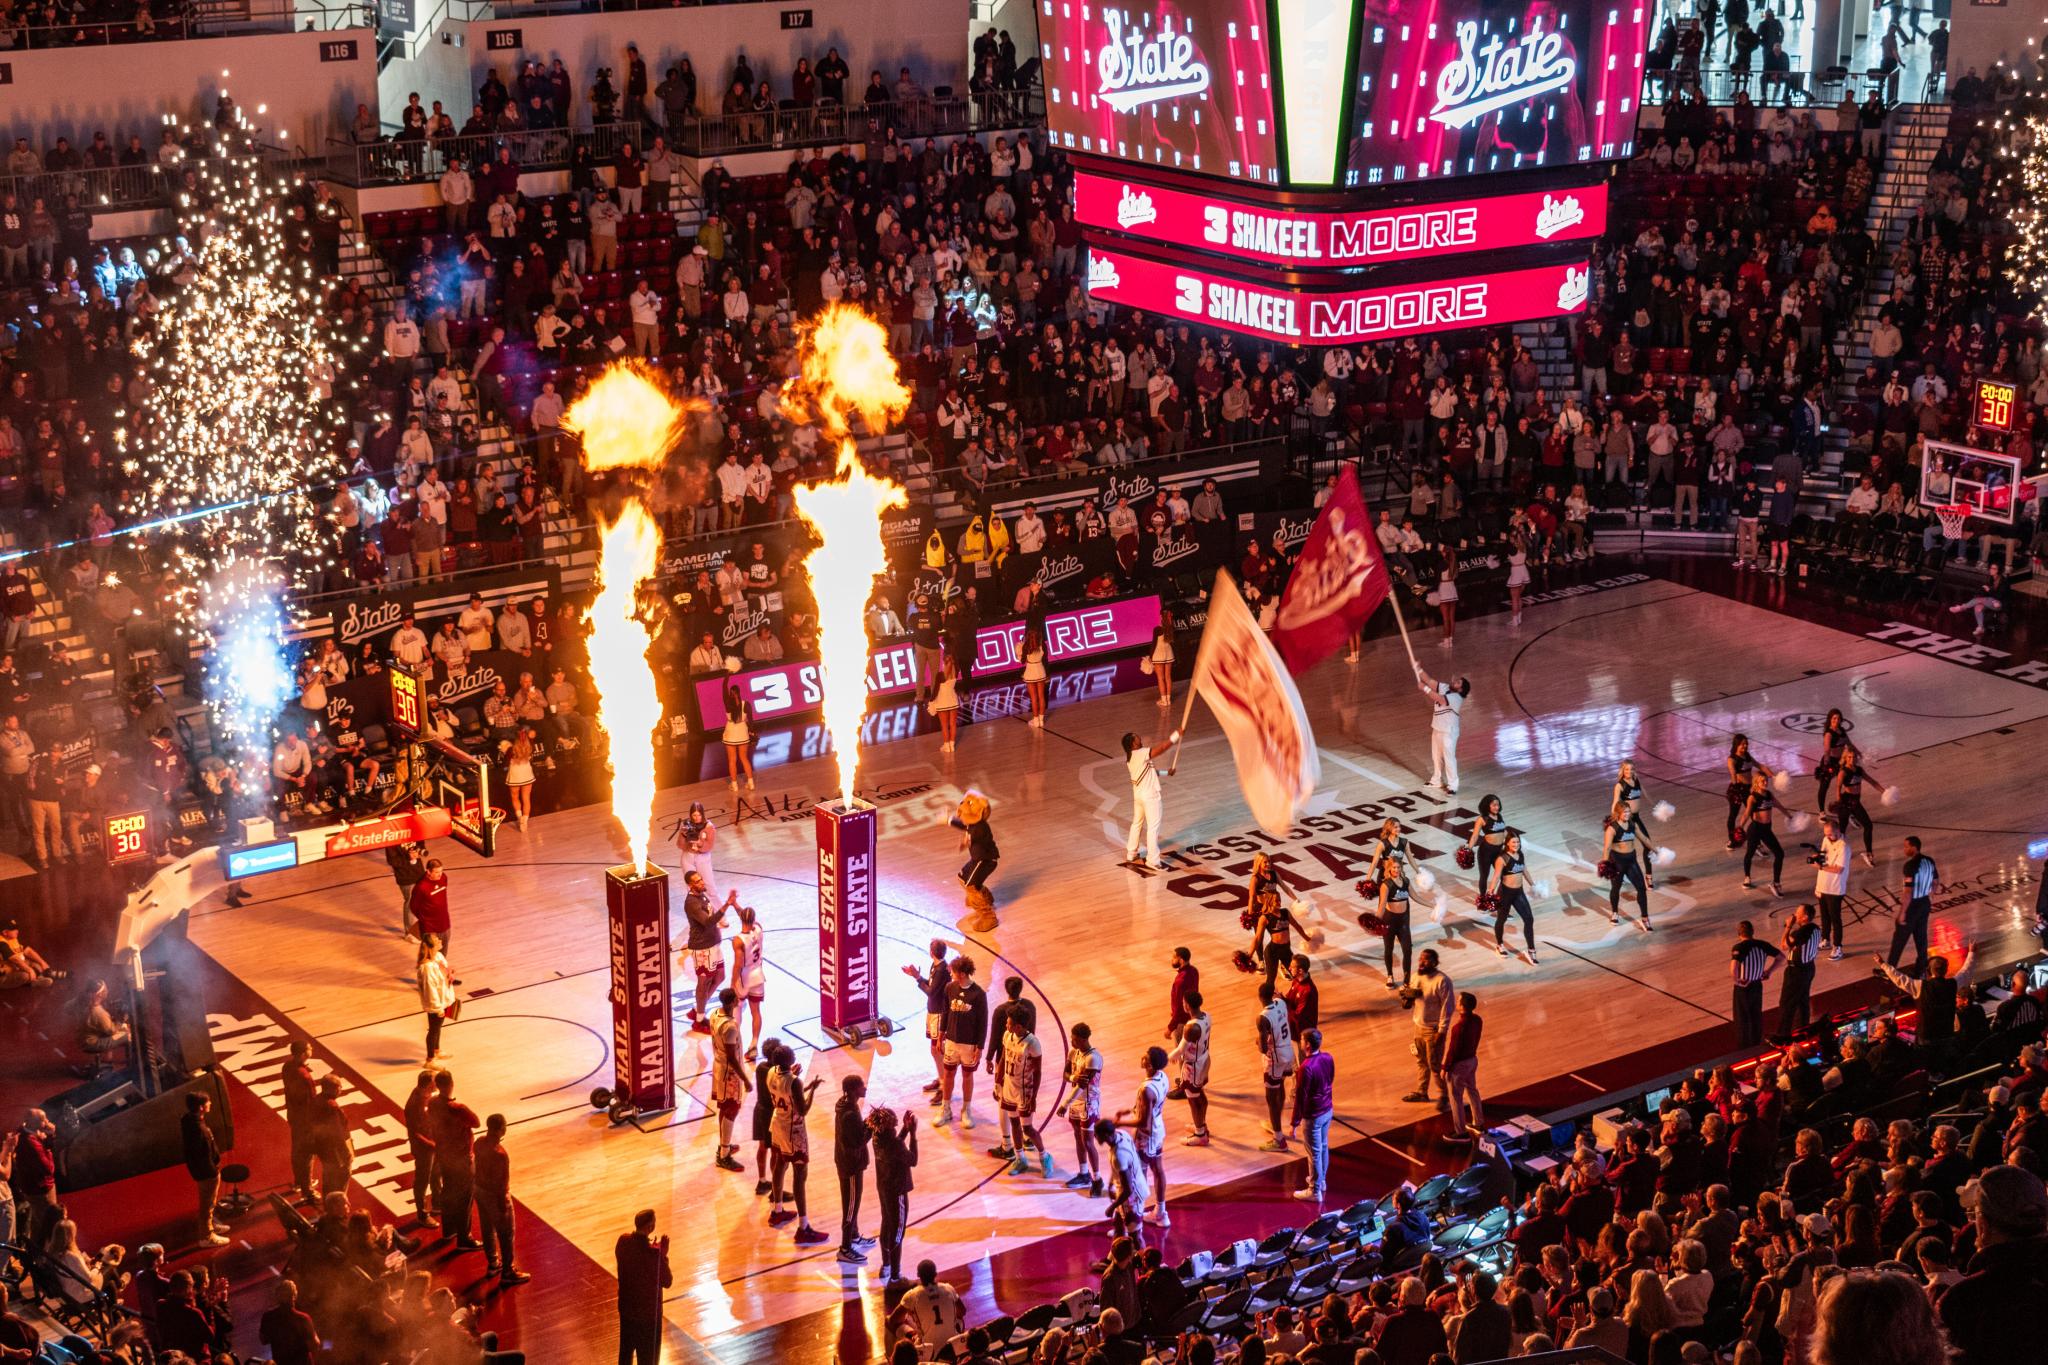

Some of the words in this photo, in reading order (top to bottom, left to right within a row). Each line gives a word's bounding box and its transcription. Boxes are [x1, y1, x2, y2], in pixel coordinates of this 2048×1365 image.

[788, 13, 805, 27] 117
[328, 43, 349, 58] 116
[495, 33, 514, 46] 116
[1098, 8, 1210, 114] State
[1428, 20, 1576, 130] State
[1204, 205, 1228, 245] 3
[1231, 210, 1323, 259] SHAKEEL
[1329, 207, 1478, 259] MOORE
[1175, 274, 1204, 315] 3
[1208, 282, 1302, 337] SHAKEEL
[1309, 282, 1488, 338] MOORE
[1980, 384, 2013, 403] 20:00
[1982, 399, 2009, 425] 30
[1102, 474, 1156, 511] State
[1087, 527, 1099, 538] 13
[1152, 533, 1200, 568] Stat
[1036, 553, 1084, 589] State
[340, 600, 404, 646] State
[1866, 621, 2013, 666] THE
[438, 665, 502, 704] State
[749, 671, 793, 714] 3
[395, 689, 418, 728] 30
[877, 783, 934, 802] COURT
[108, 814, 146, 836] 20:00
[179, 808, 207, 824] ALFA
[117, 831, 141, 853] 30
[1166, 806, 1527, 911] STATE
[819, 848, 836, 934] STATE
[846, 852, 870, 937] STATE
[610, 916, 627, 1005] STATE
[636, 919, 662, 1009] STATE
[751, 950, 761, 964] 3
[1281, 1022, 1290, 1040] 5
[614, 1018, 631, 1086] HAIL
[640, 1018, 666, 1089] HAIL
[932, 1305, 944, 1326] 1
